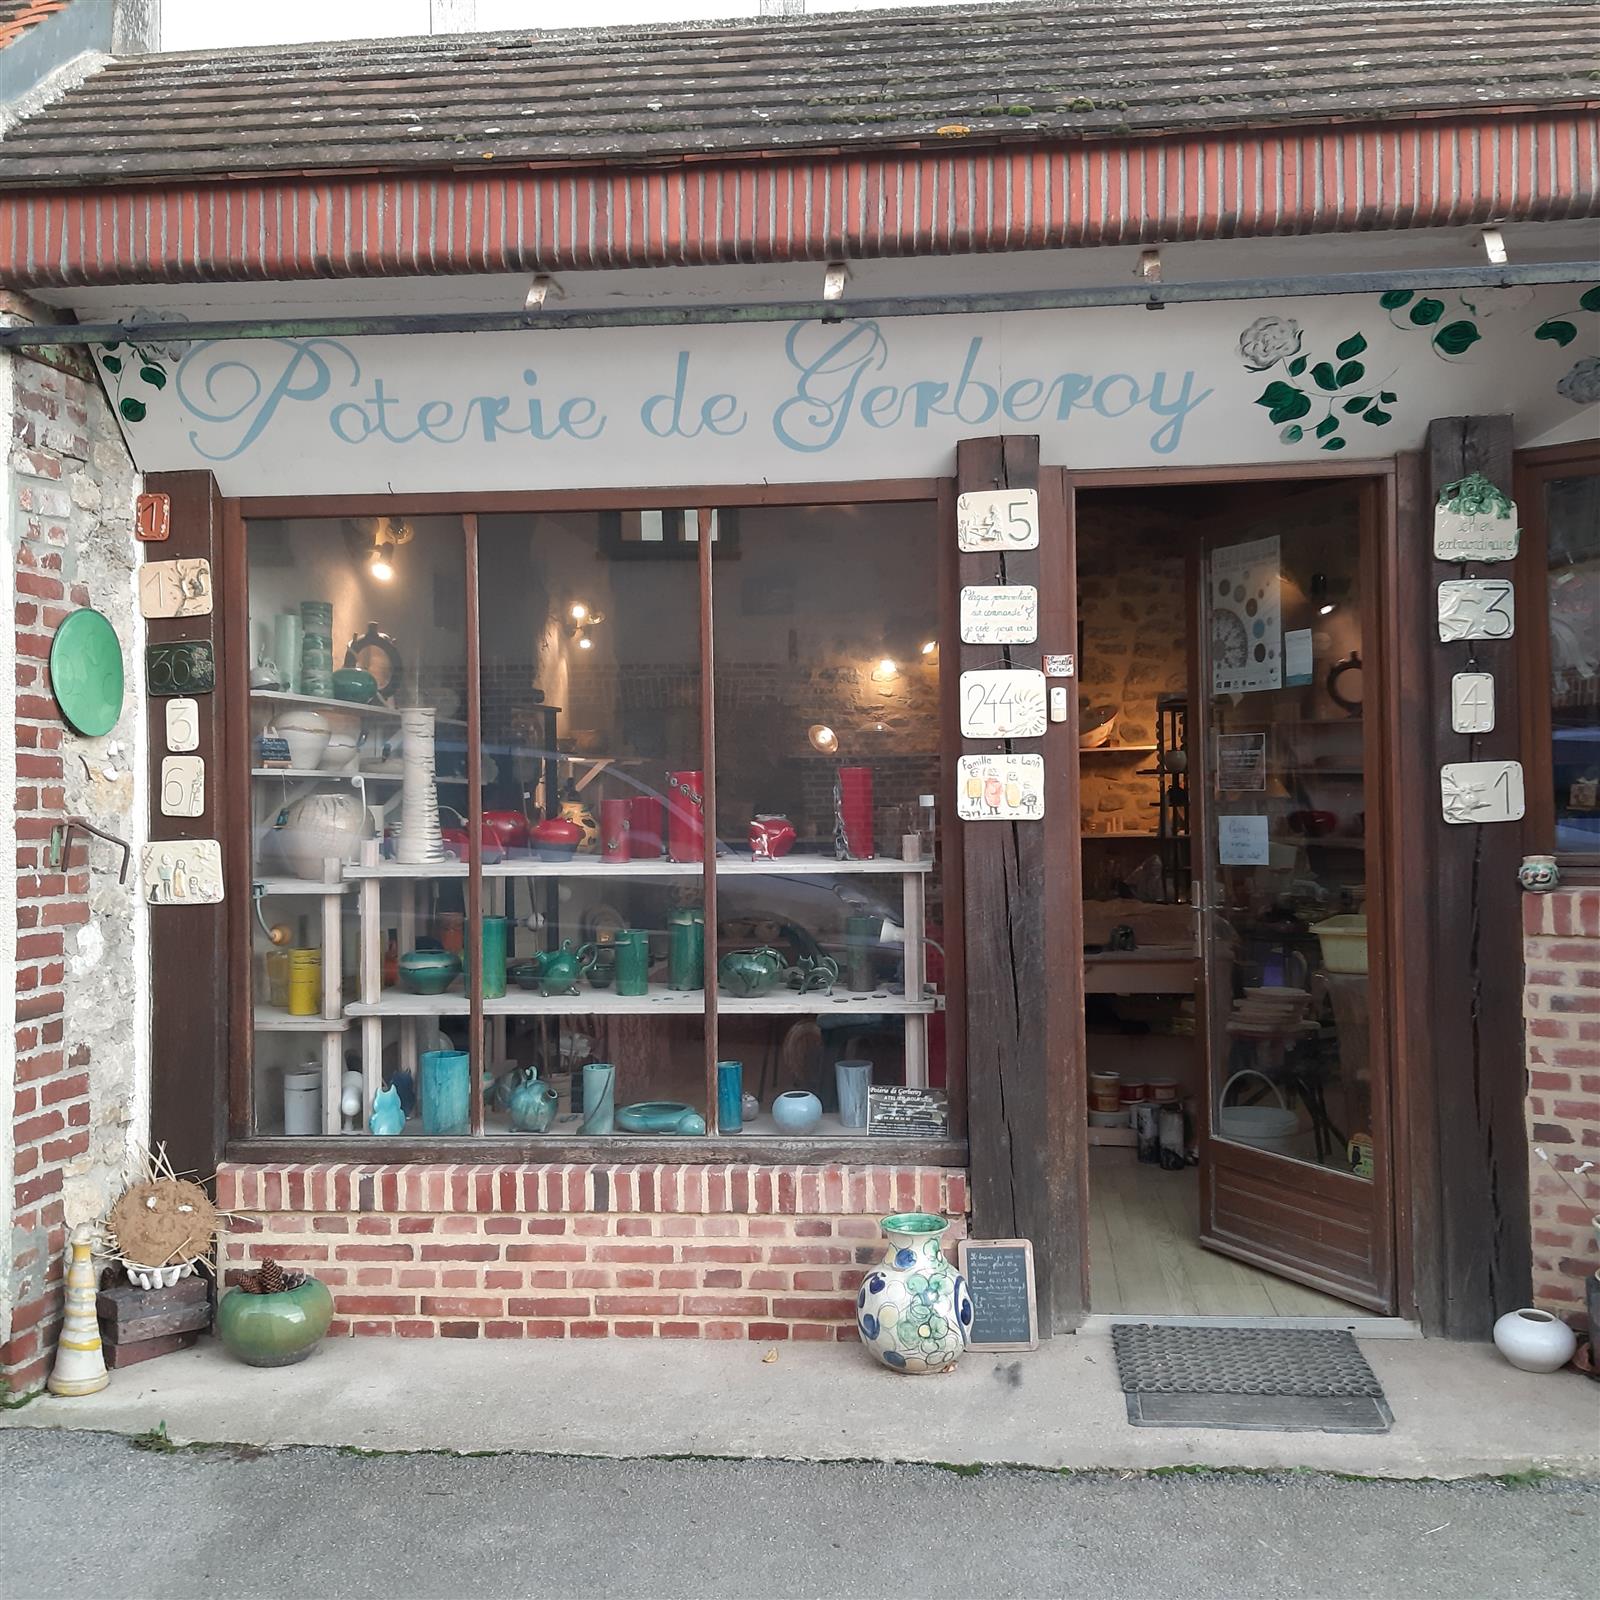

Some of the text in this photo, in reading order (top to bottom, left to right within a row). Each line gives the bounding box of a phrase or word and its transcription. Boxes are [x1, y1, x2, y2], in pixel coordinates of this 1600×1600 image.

[175, 318, 1216, 462] Poterie de Gerberoy
[142, 501, 157, 532] 1
[1008, 501, 1032, 542] 5
[145, 571, 164, 608] 1
[1482, 587, 1511, 636] 3
[967, 682, 1015, 725] 244
[1460, 680, 1488, 723] 4
[171, 707, 192, 744] 3
[1493, 771, 1511, 815] 1
